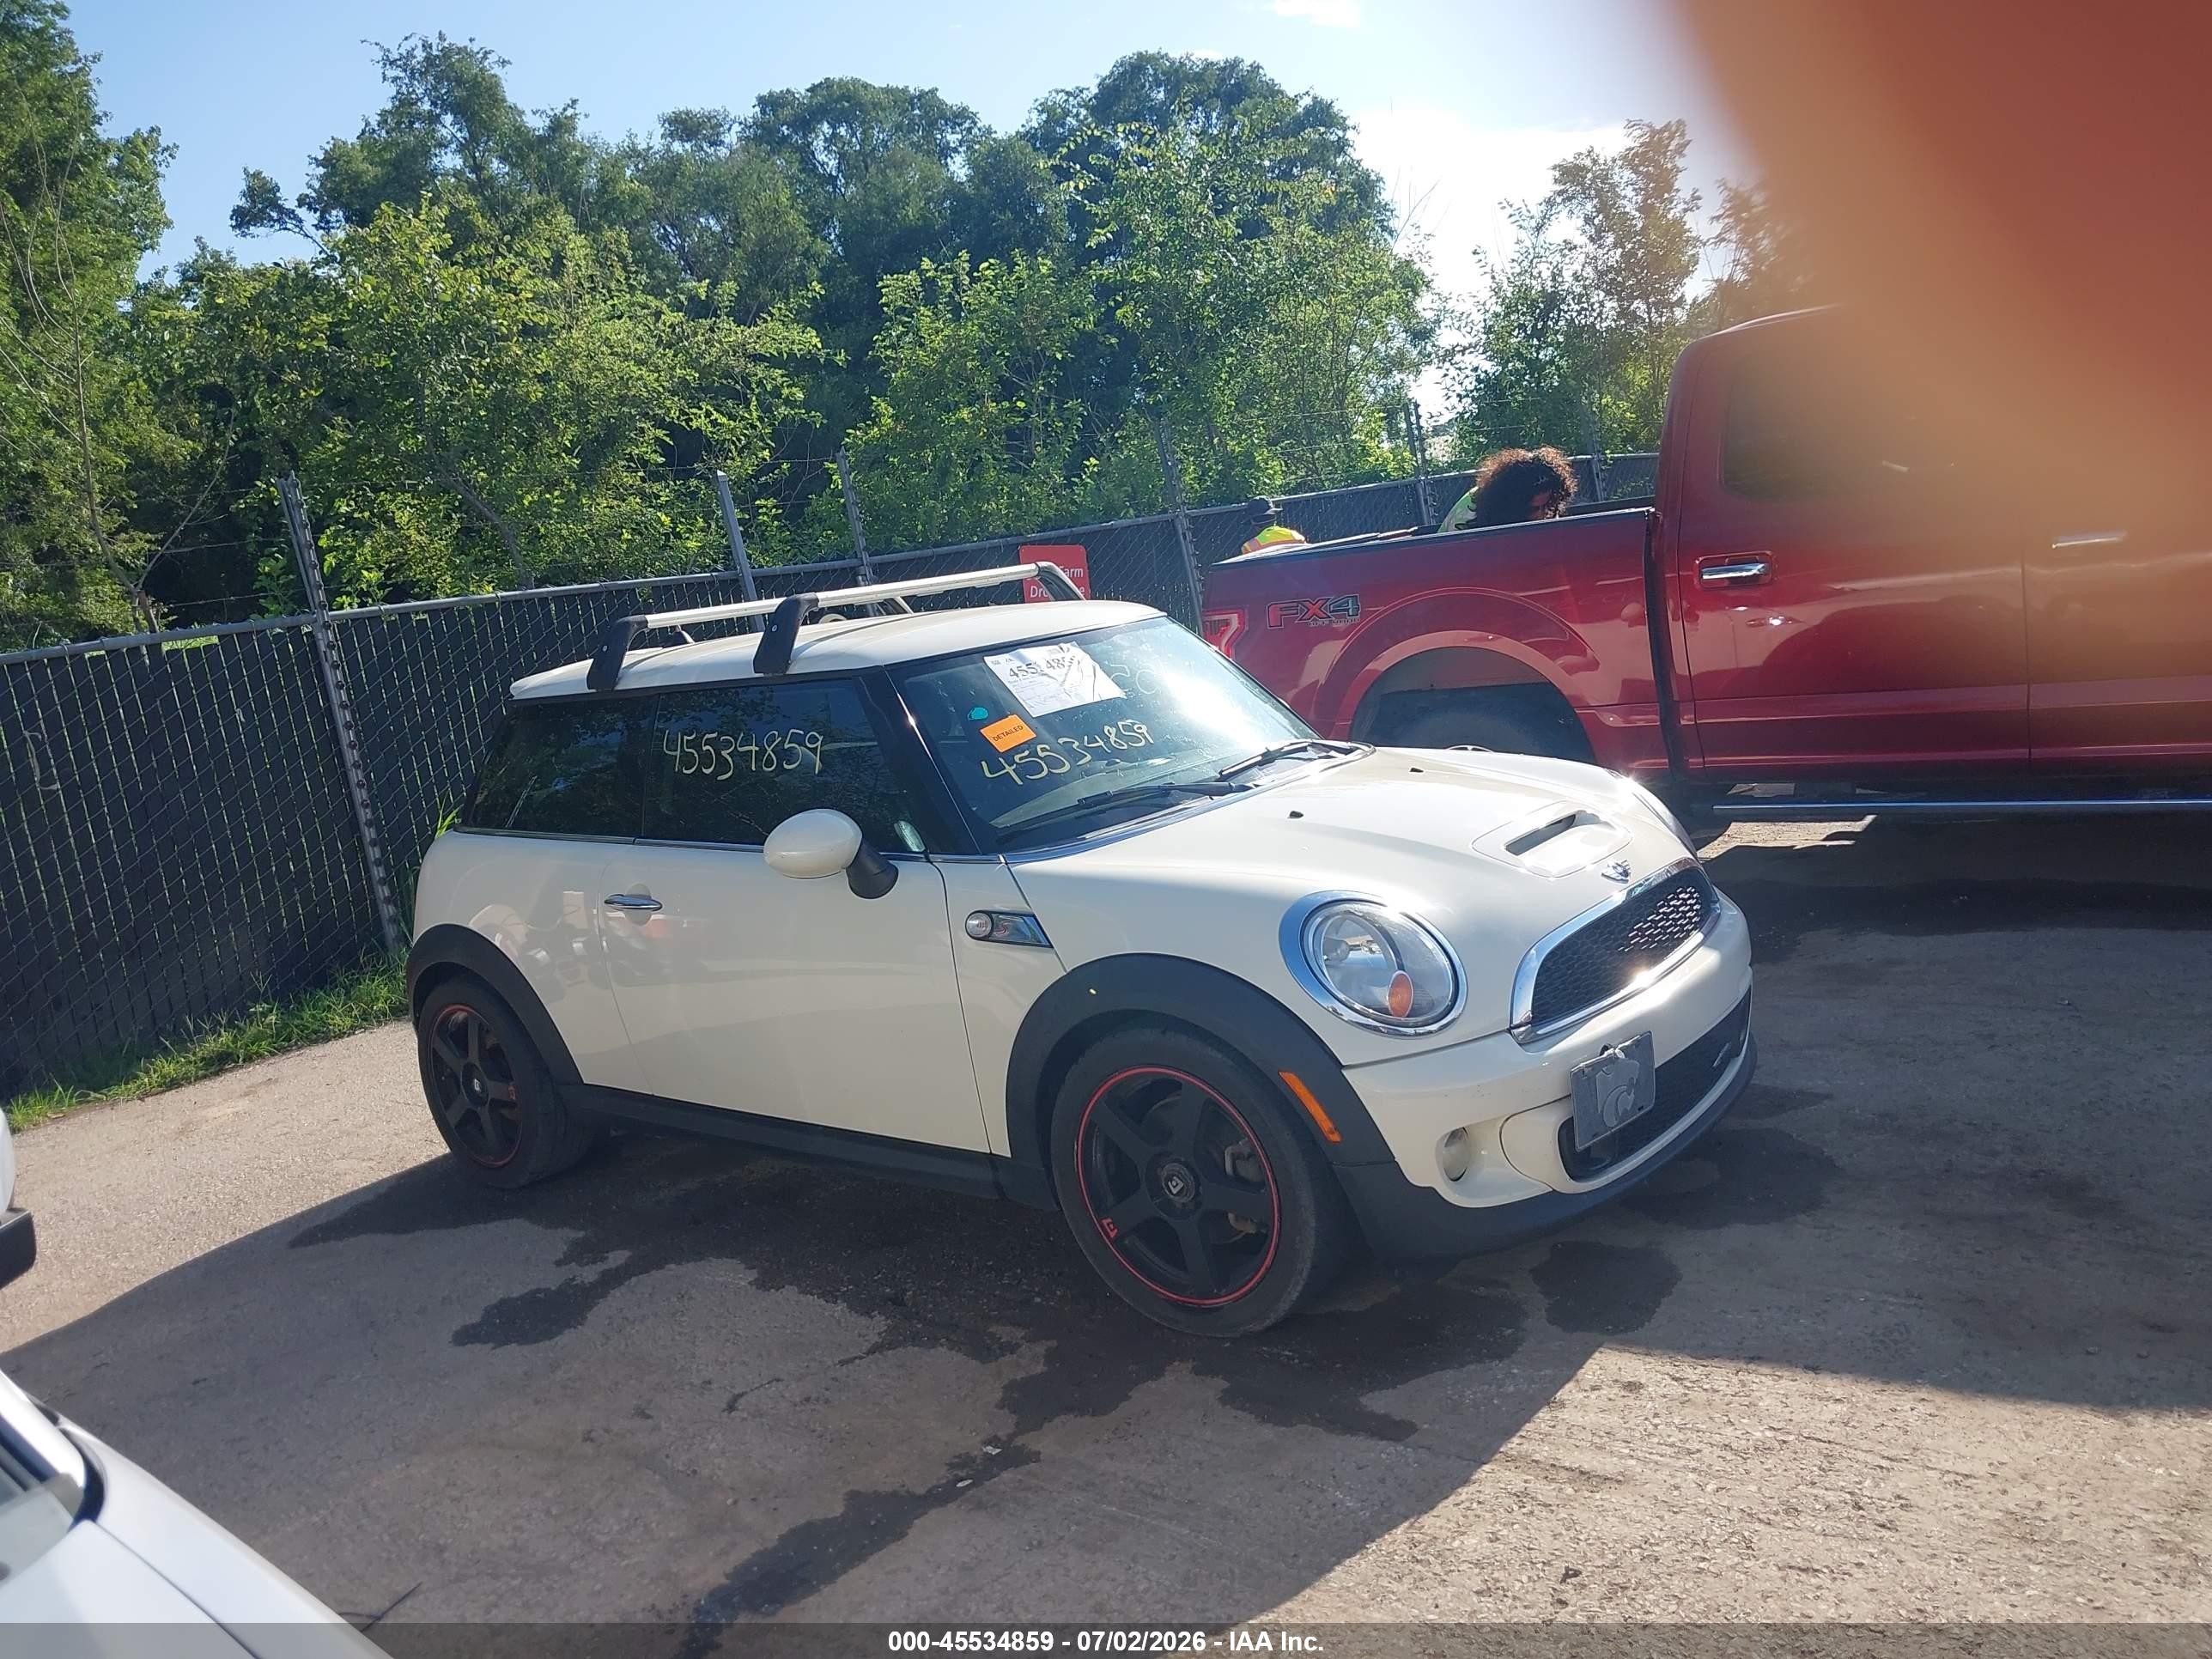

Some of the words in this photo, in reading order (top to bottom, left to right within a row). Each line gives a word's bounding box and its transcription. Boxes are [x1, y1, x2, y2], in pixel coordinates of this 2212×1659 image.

[1060, 565, 1084, 578] arm
[1267, 593, 1361, 629] FX4
[992, 724, 1024, 743] DETAILED
[663, 728, 824, 781] 45534859
[981, 719, 1155, 786] 45534859
